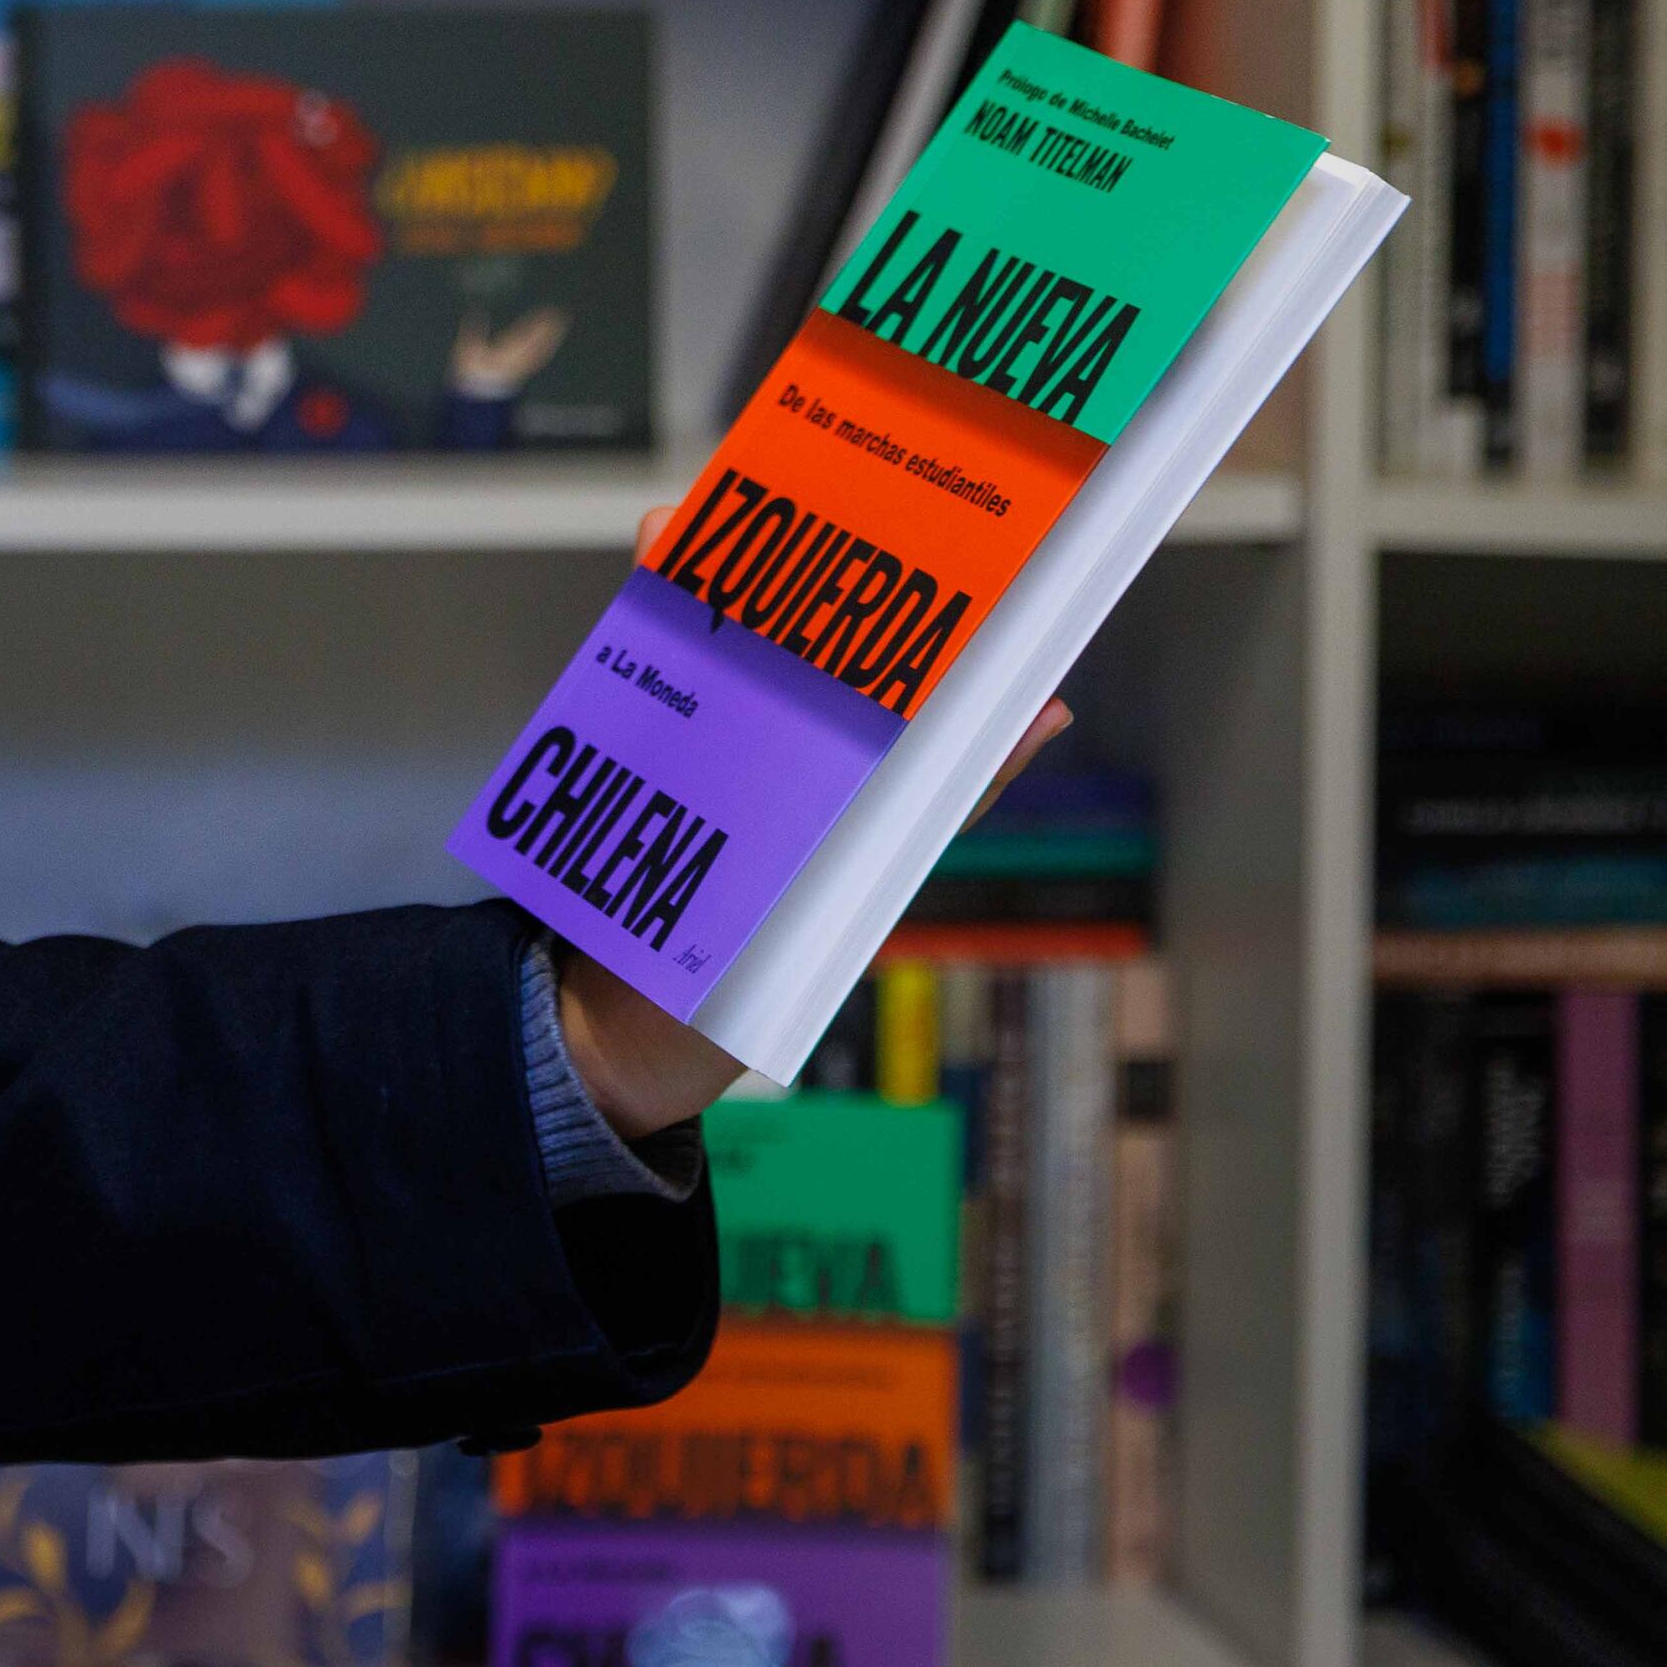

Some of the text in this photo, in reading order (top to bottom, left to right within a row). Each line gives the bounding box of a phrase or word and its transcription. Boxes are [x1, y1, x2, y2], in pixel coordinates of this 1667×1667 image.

[964, 99, 1133, 193] NOAM TITELMAN
[998, 68, 1175, 151] Prólogo de Michelle Bachelet
[835, 209, 1143, 427] LA NUEVA
[778, 384, 1012, 518] De las marchas estudiantiles
[656, 467, 974, 715] IZQUIERDA
[596, 646, 699, 719] a La Moneda
[486, 726, 730, 953] CHILENA
